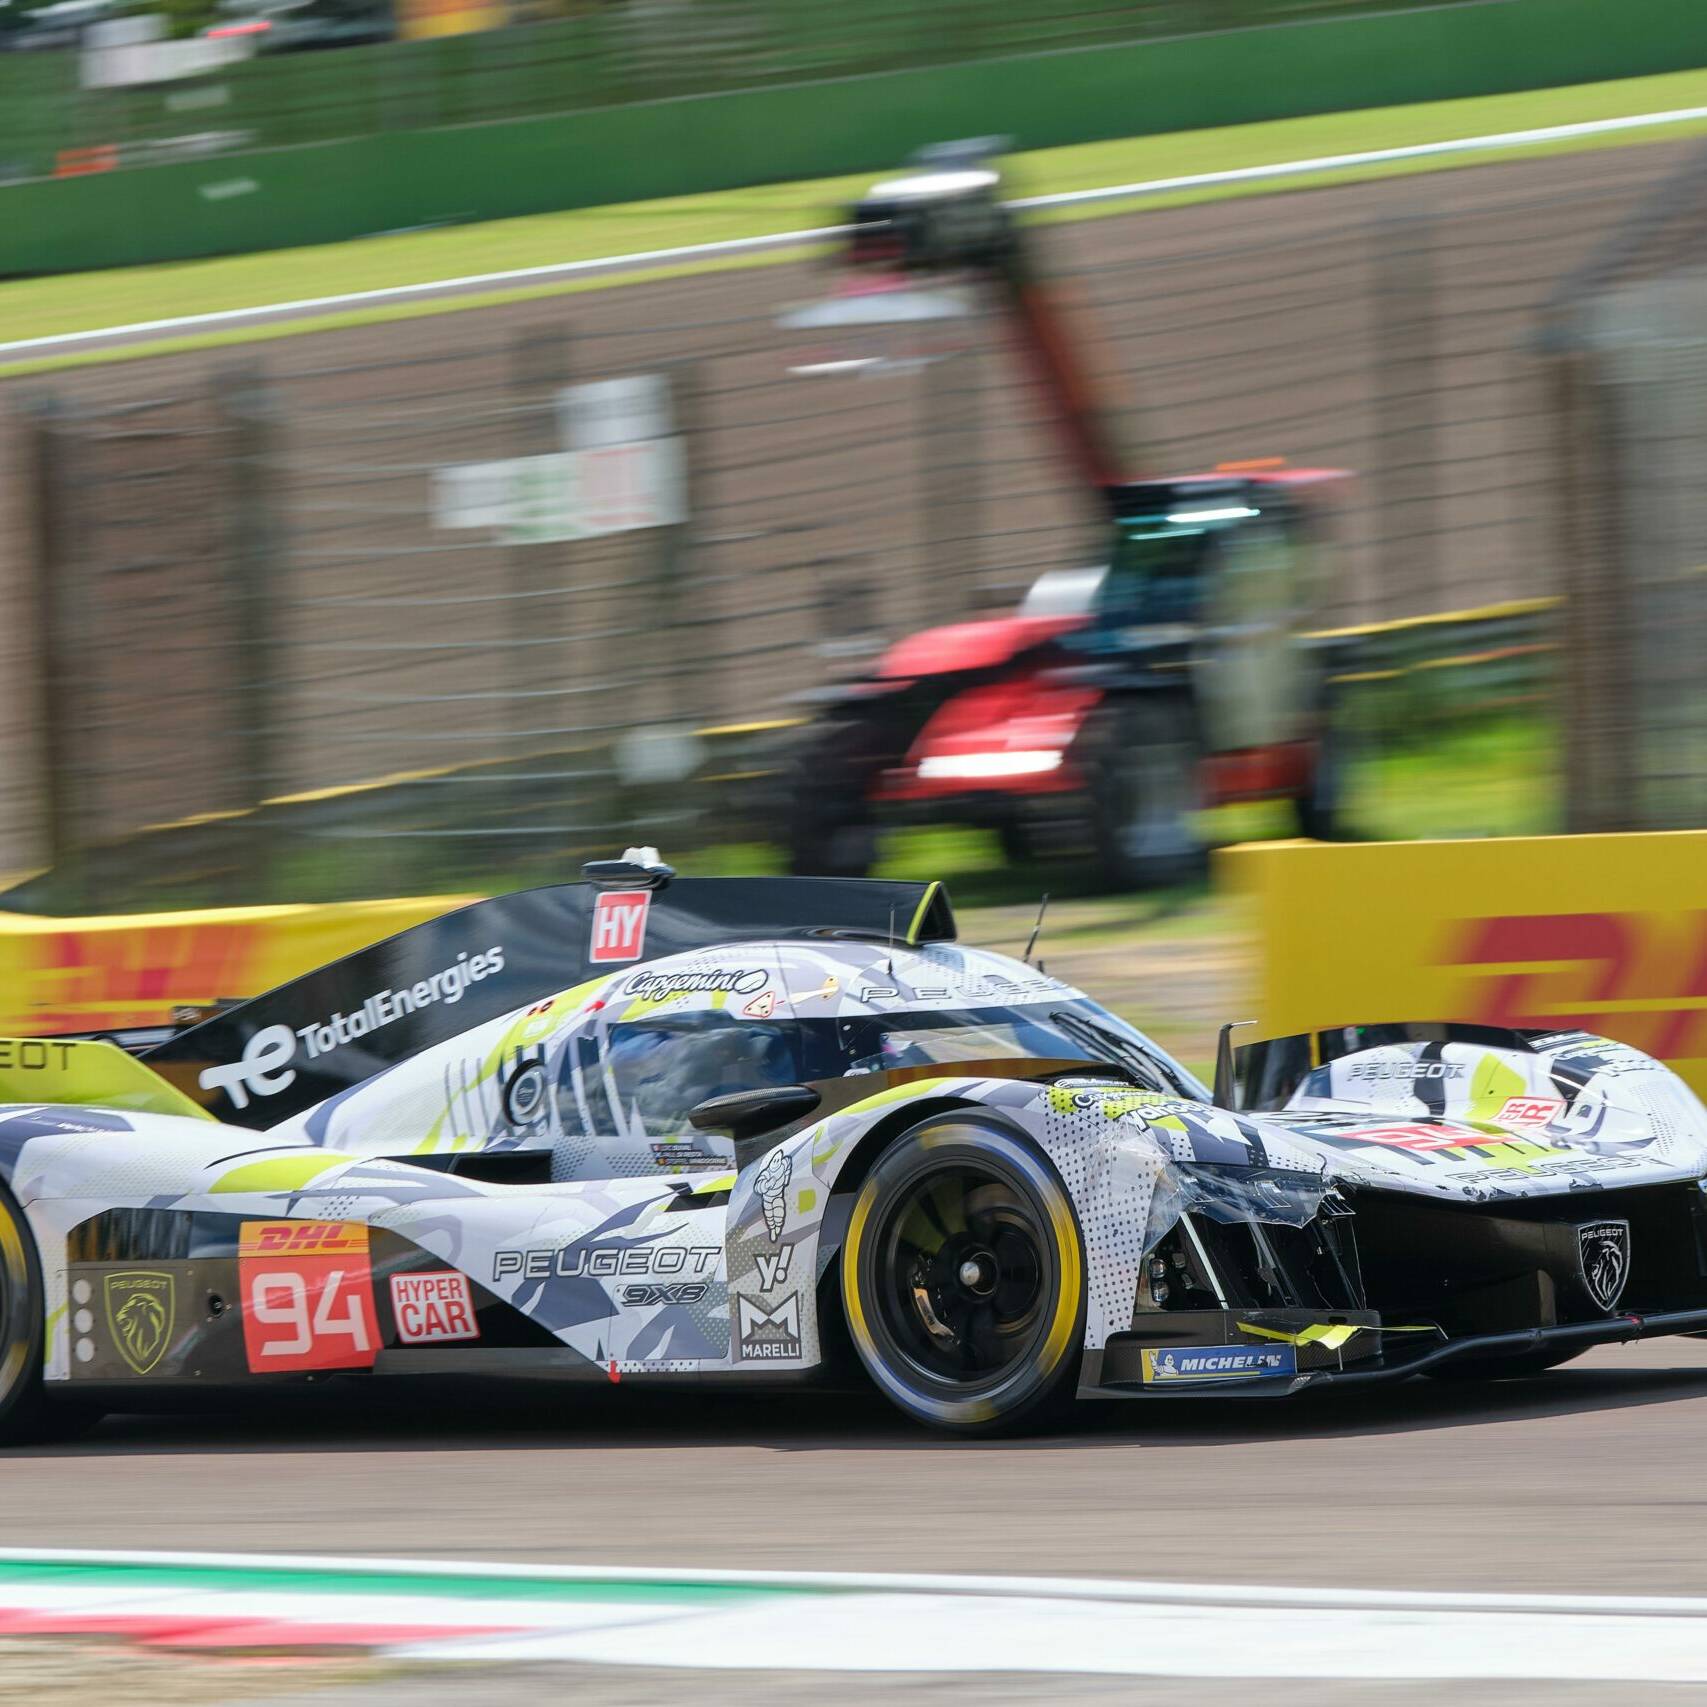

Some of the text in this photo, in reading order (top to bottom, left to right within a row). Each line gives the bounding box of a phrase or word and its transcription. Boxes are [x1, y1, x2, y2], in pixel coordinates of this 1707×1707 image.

[596, 904, 643, 948] HY
[624, 969, 743, 1002] Capgemini
[296, 945, 504, 1059] TotalEnergies
[1347, 1063, 1466, 1082] PEUGEOT
[1446, 1155, 1676, 1184] PEUGEOT
[257, 1224, 348, 1250] DHL
[1581, 1228, 1624, 1240] PEUGEOT
[493, 1246, 722, 1281] PEUGEOT
[397, 1278, 463, 1302] HYPER
[620, 1282, 709, 1307] 9X8
[252, 1270, 370, 1356] 94
[402, 1301, 472, 1337] CAR
[742, 1344, 801, 1359] MARELLI
